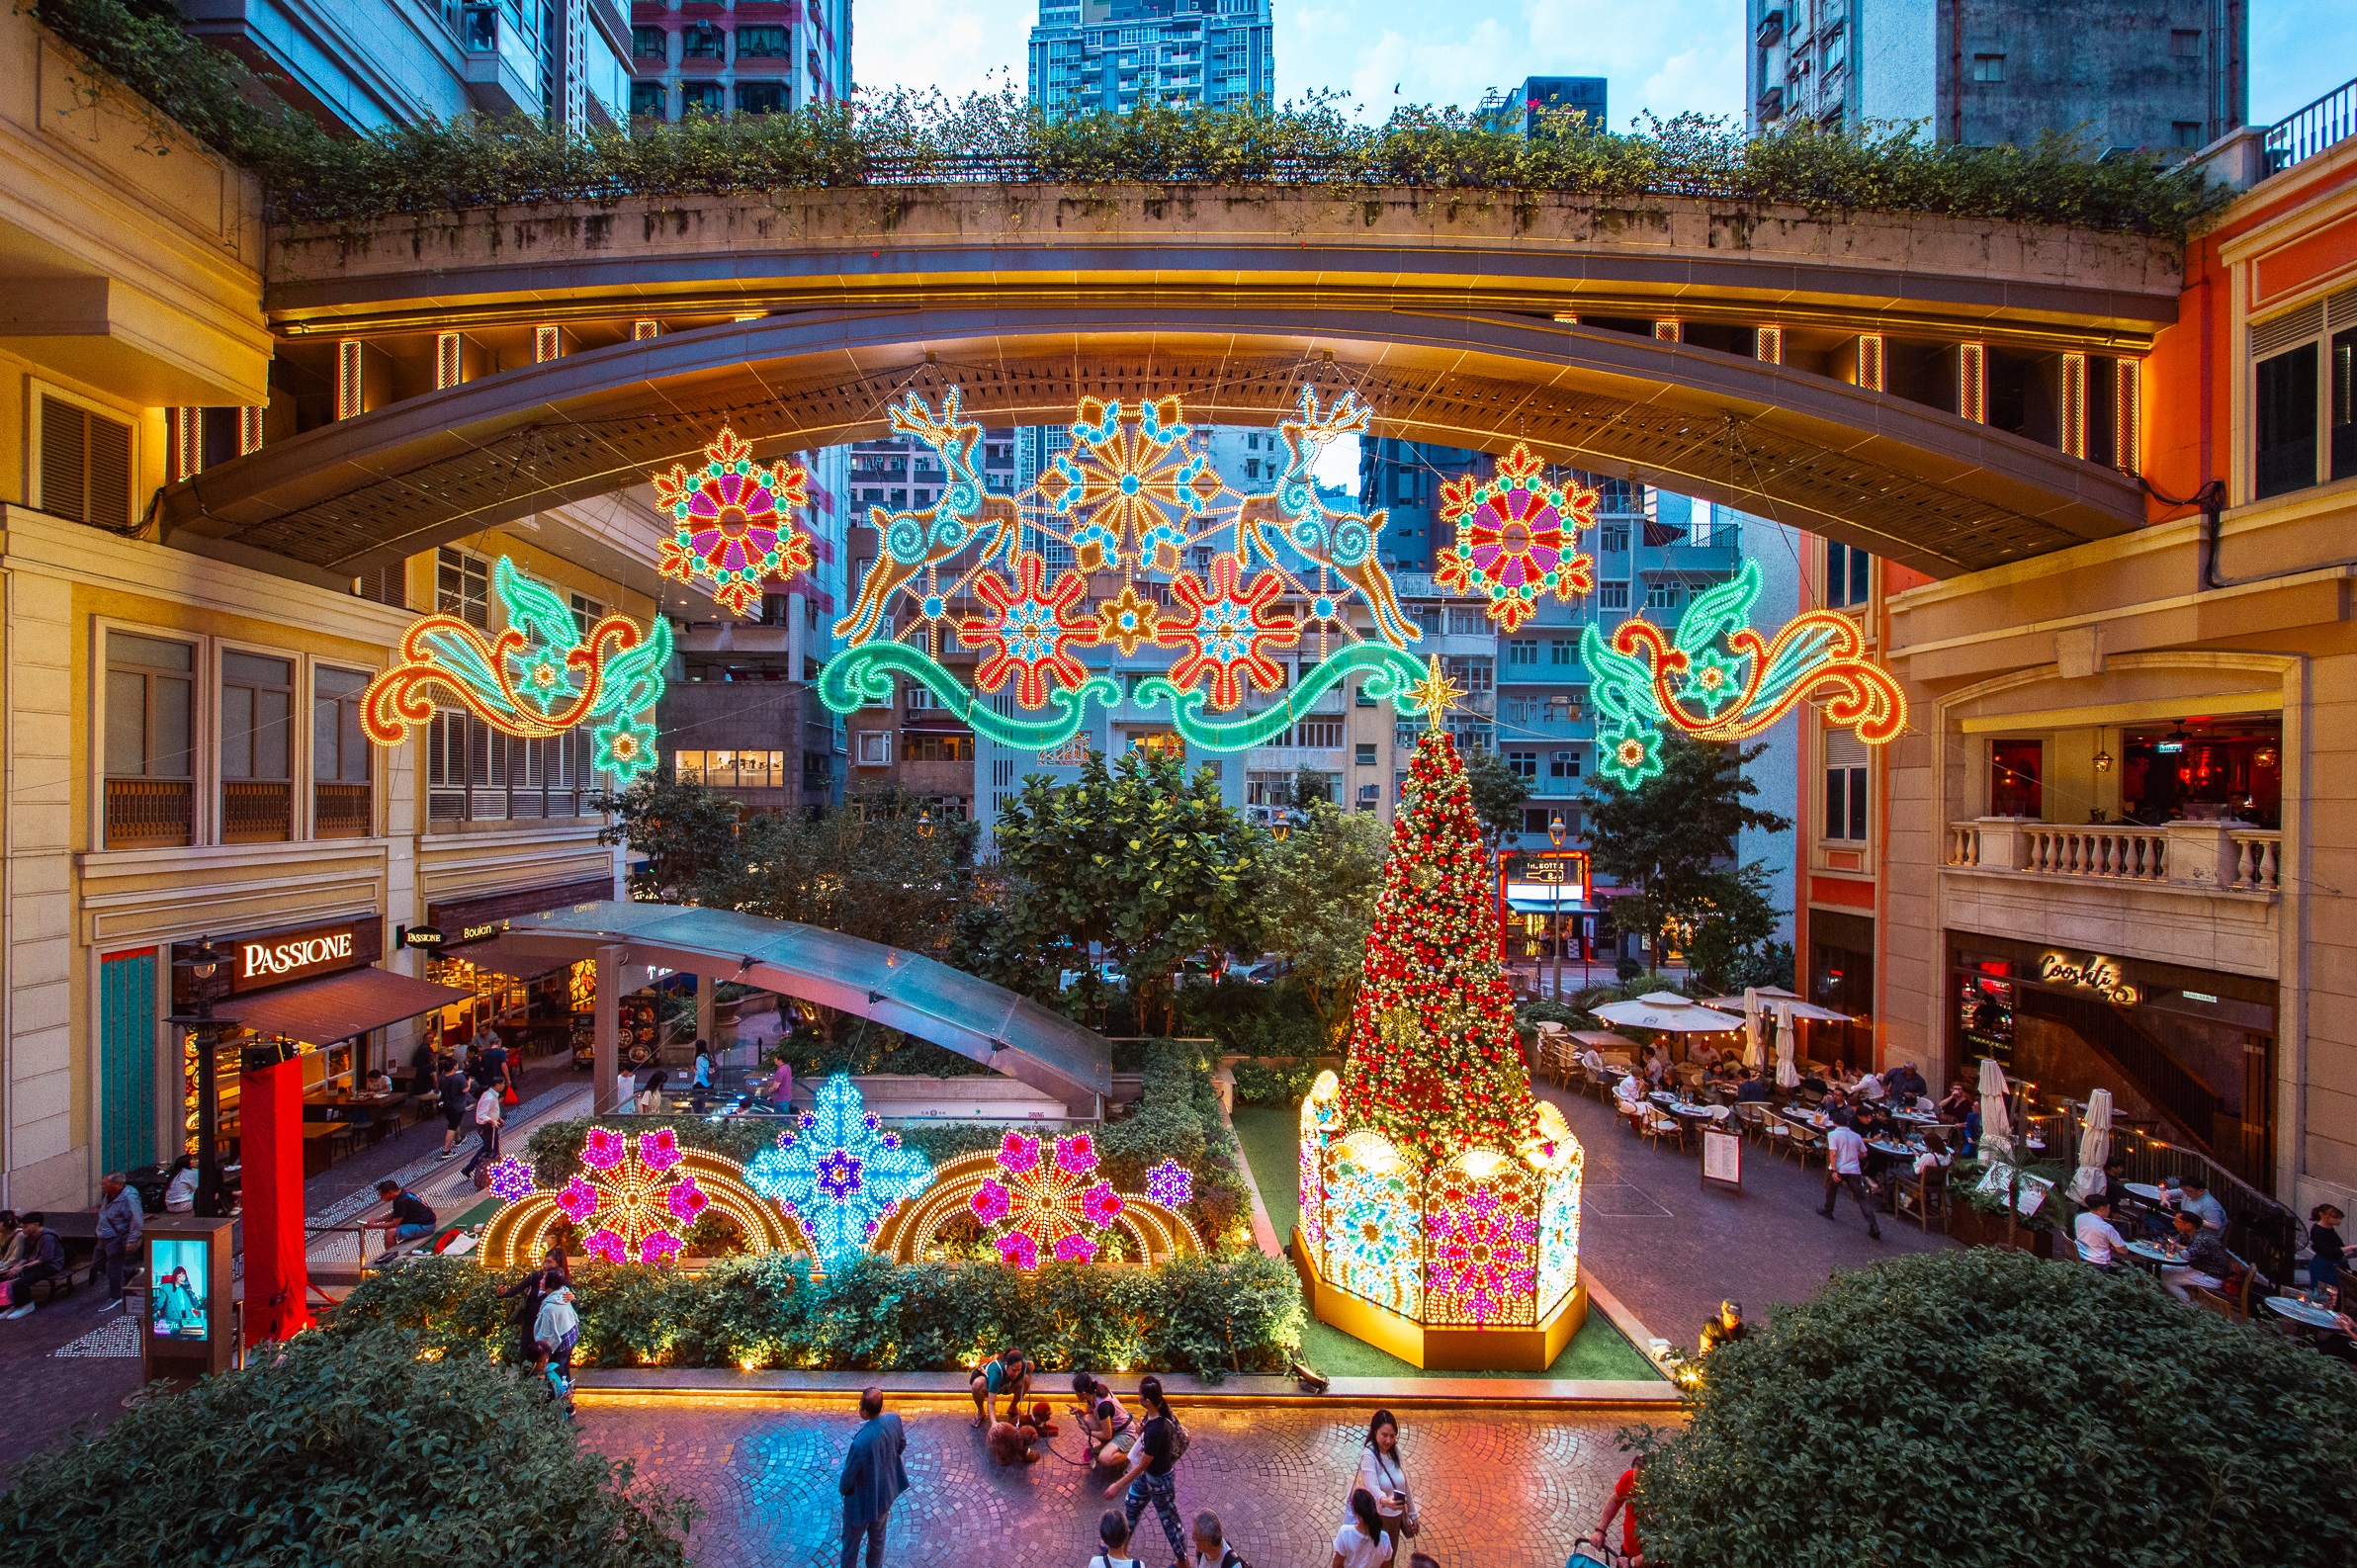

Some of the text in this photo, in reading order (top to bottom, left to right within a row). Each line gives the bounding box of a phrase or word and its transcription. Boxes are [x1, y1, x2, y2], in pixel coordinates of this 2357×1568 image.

[406, 932, 441, 943] PASSIONE
[464, 924, 492, 938] Boulan
[243, 933, 352, 977] PASSIONE
[2041, 955, 2112, 988] Cooshti
